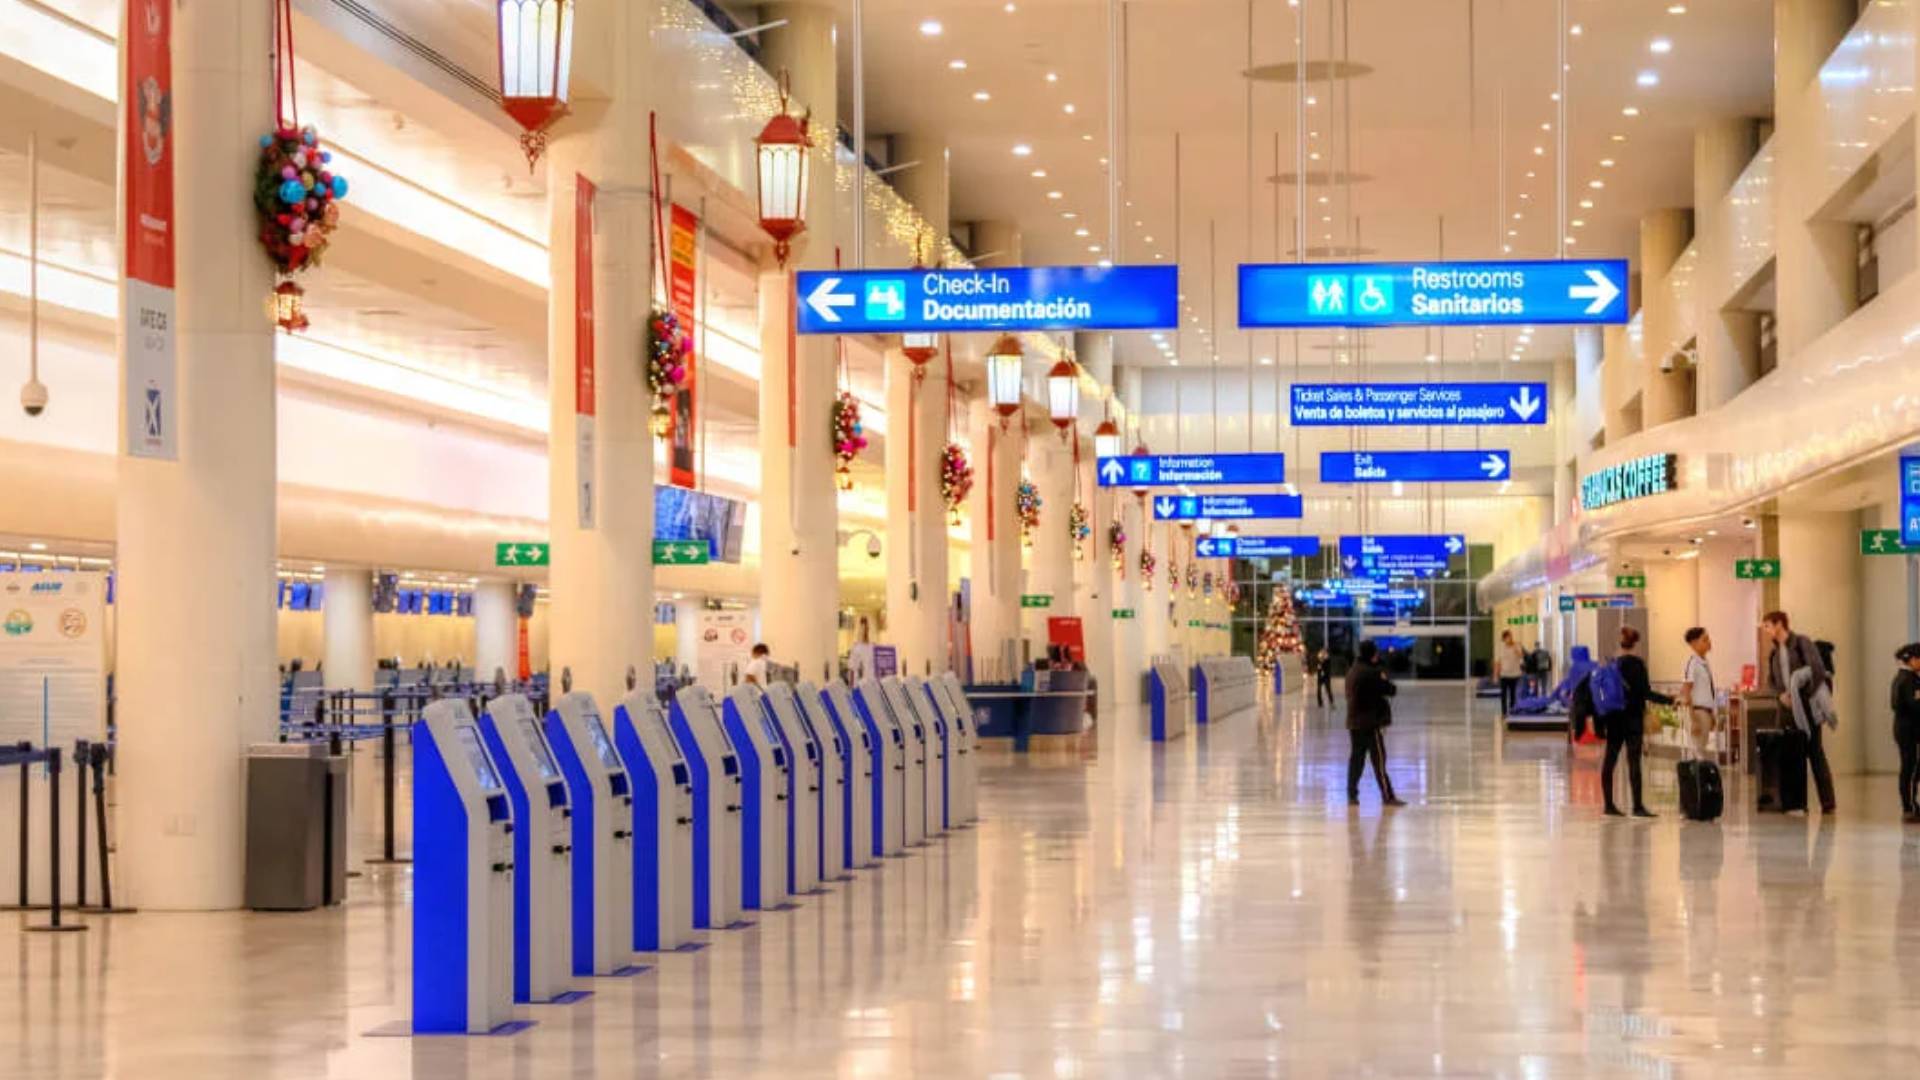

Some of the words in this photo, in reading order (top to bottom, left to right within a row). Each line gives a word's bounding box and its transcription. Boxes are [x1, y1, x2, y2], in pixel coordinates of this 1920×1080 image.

[923, 273, 1009, 295] Check-In
[1412, 268, 1524, 290] Restrooms
[923, 297, 1091, 320] Documentación
[1412, 293, 1524, 315] Sanitarios
[1294, 388, 1324, 402] Ticket
[1326, 388, 1353, 401] Sales
[1355, 388, 1362, 401] &
[1366, 388, 1417, 404] Passenger
[1419, 387, 1460, 401] Services
[1294, 406, 1327, 419] Venta
[1330, 406, 1342, 419] de
[1345, 405, 1385, 418] boletos
[1388, 408, 1395, 422] y
[1397, 405, 1444, 418] servicios
[1447, 405, 1456, 418] al
[1458, 405, 1505, 421] pasajero
[1159, 458, 1214, 469] Information
[1354, 454, 1373, 466] Exit
[1159, 470, 1223, 481] Información
[1354, 466, 1387, 478] Salida
[1623, 453, 1668, 500] COFFEE
